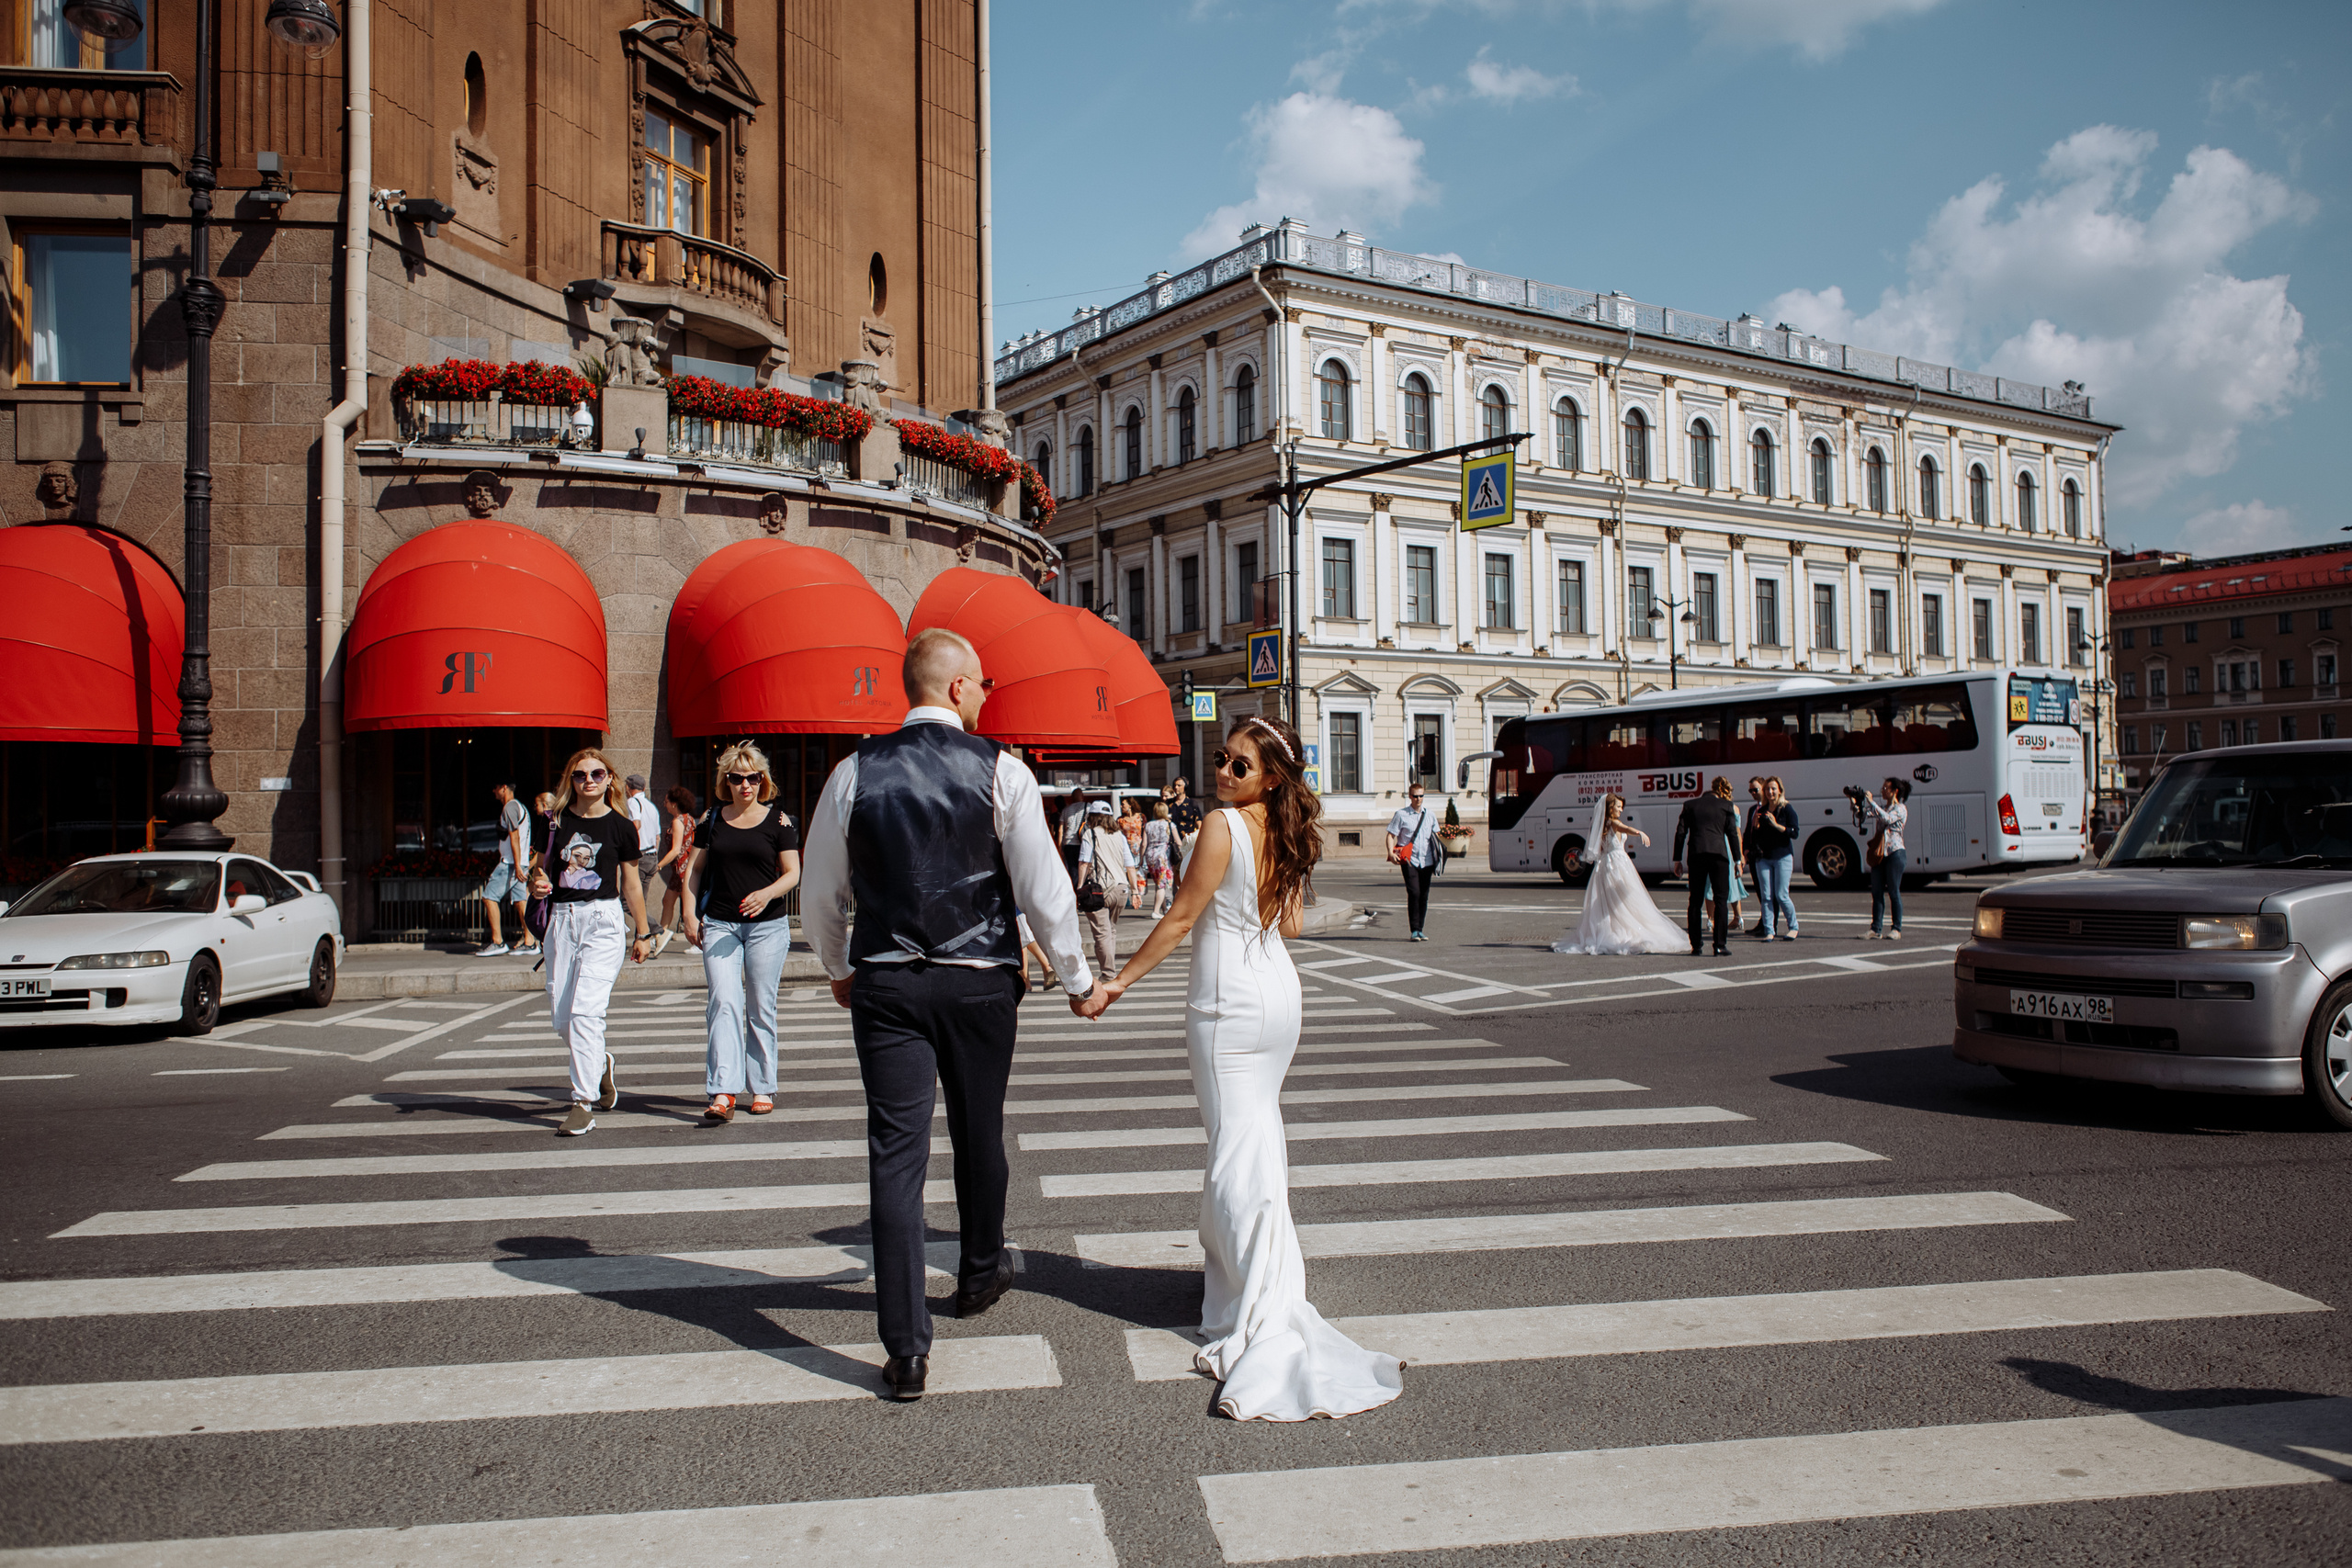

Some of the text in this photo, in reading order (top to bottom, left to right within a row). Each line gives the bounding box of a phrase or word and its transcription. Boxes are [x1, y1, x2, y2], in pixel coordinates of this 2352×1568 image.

[1577, 786, 1593, 795] (812)
[16, 981, 46, 995] PWL
[2088, 998, 2107, 1015] 98
